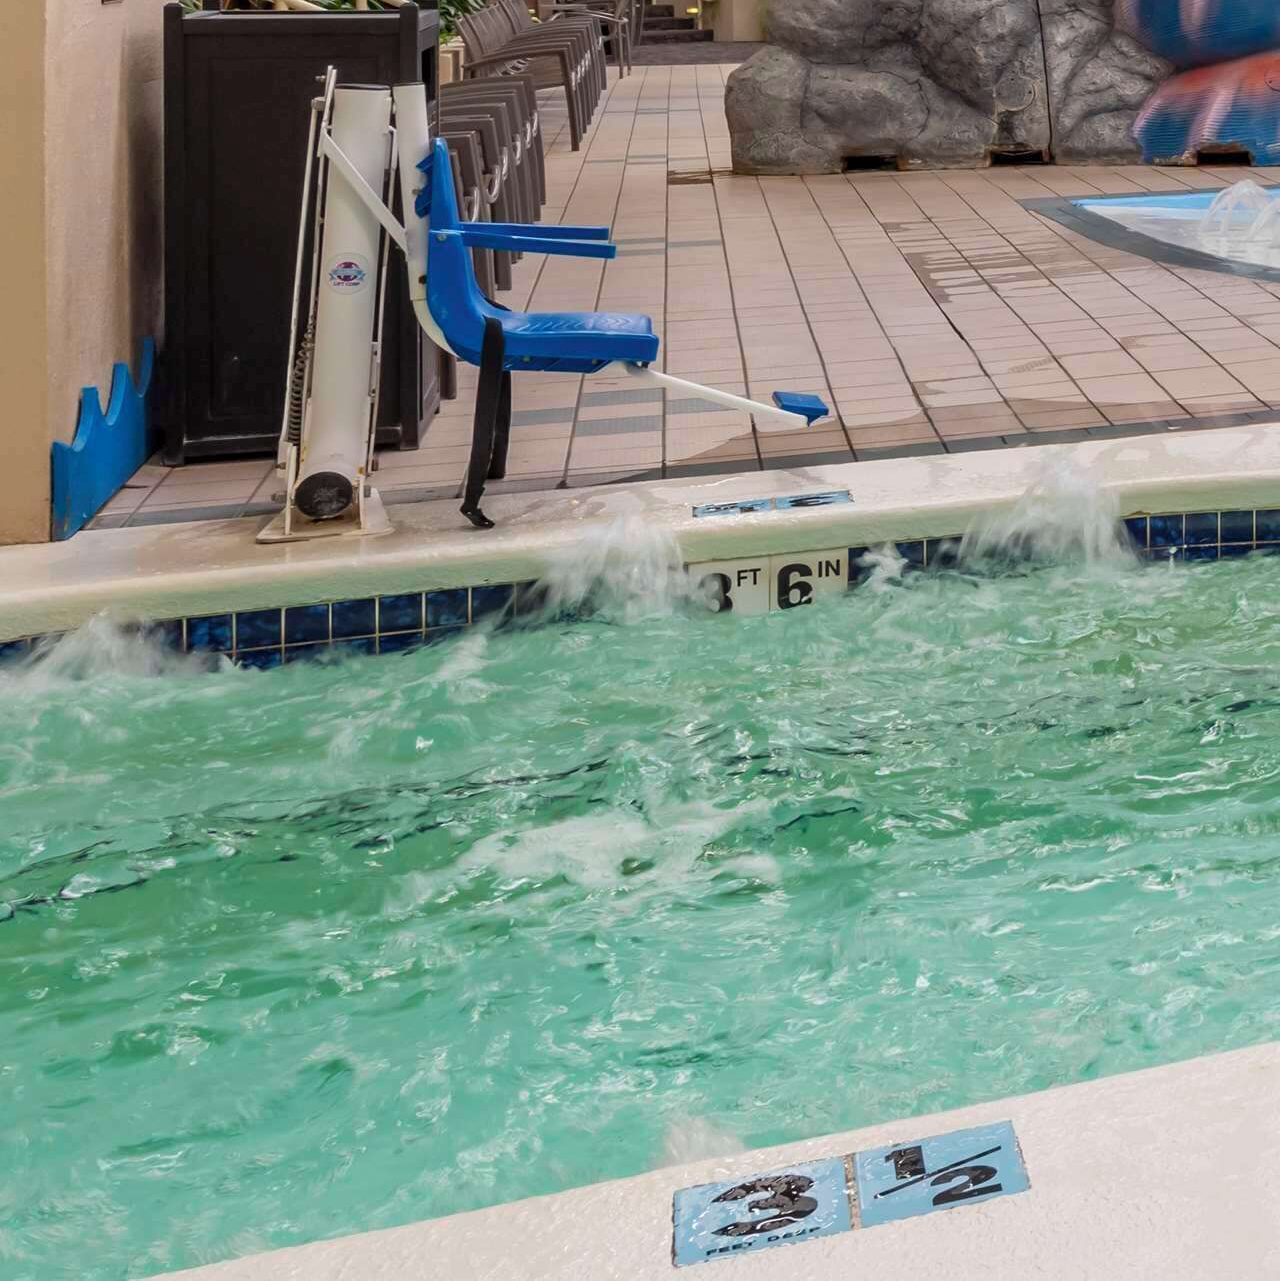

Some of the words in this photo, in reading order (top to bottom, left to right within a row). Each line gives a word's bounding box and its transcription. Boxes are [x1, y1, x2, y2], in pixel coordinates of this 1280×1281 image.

[699, 572, 733, 612] 3
[737, 568, 761, 587] FT
[777, 563, 813, 610] 6
[818, 559, 841, 578] IN
[711, 1174, 819, 1237] 3
